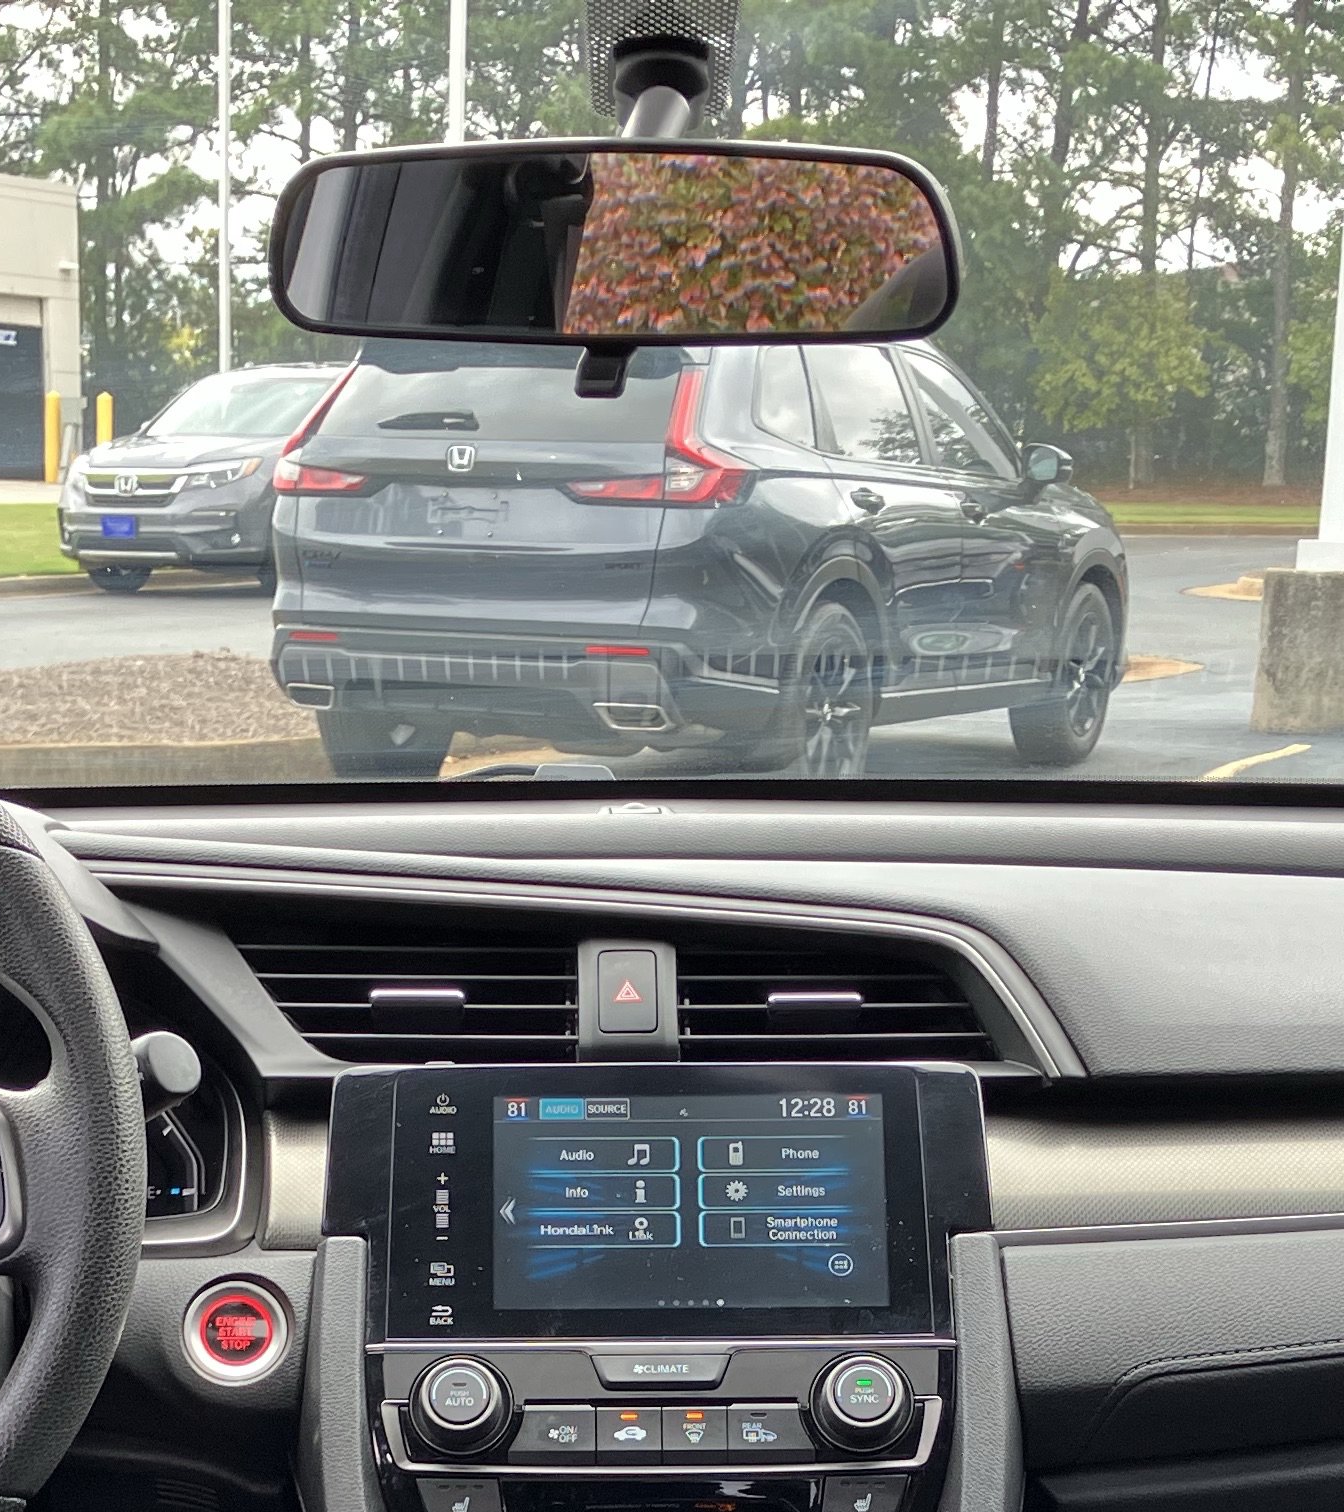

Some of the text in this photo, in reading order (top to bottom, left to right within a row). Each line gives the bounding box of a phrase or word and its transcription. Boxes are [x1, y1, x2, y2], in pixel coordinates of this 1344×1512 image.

[430, 1106, 457, 1114] AUDIO
[507, 1101, 526, 1117] 81
[545, 1104, 579, 1114] AUDIO
[587, 1104, 626, 1114] SOURCE
[779, 1097, 836, 1117] 12:28
[847, 1099, 867, 1115] 81
[429, 1146, 456, 1154] HOME
[559, 1149, 595, 1161] Audio
[781, 1147, 820, 1159] Phone
[565, 1186, 589, 1198] Info
[777, 1185, 826, 1197] Settings
[432, 1205, 451, 1213] VOL
[766, 1216, 838, 1229] Smartphone
[540, 1224, 615, 1236] HondaLink
[768, 1229, 837, 1241] Connection
[428, 1278, 455, 1286] MENU
[215, 1316, 256, 1326] ENGINE
[429, 1317, 454, 1325] BACK
[218, 1327, 253, 1337] START
[221, 1340, 250, 1350] STOP
[643, 1364, 689, 1374] CLIMATE
[445, 1397, 475, 1406] AUTO
[850, 1394, 879, 1404] SYNC
[558, 1434, 578, 1443] OFF
